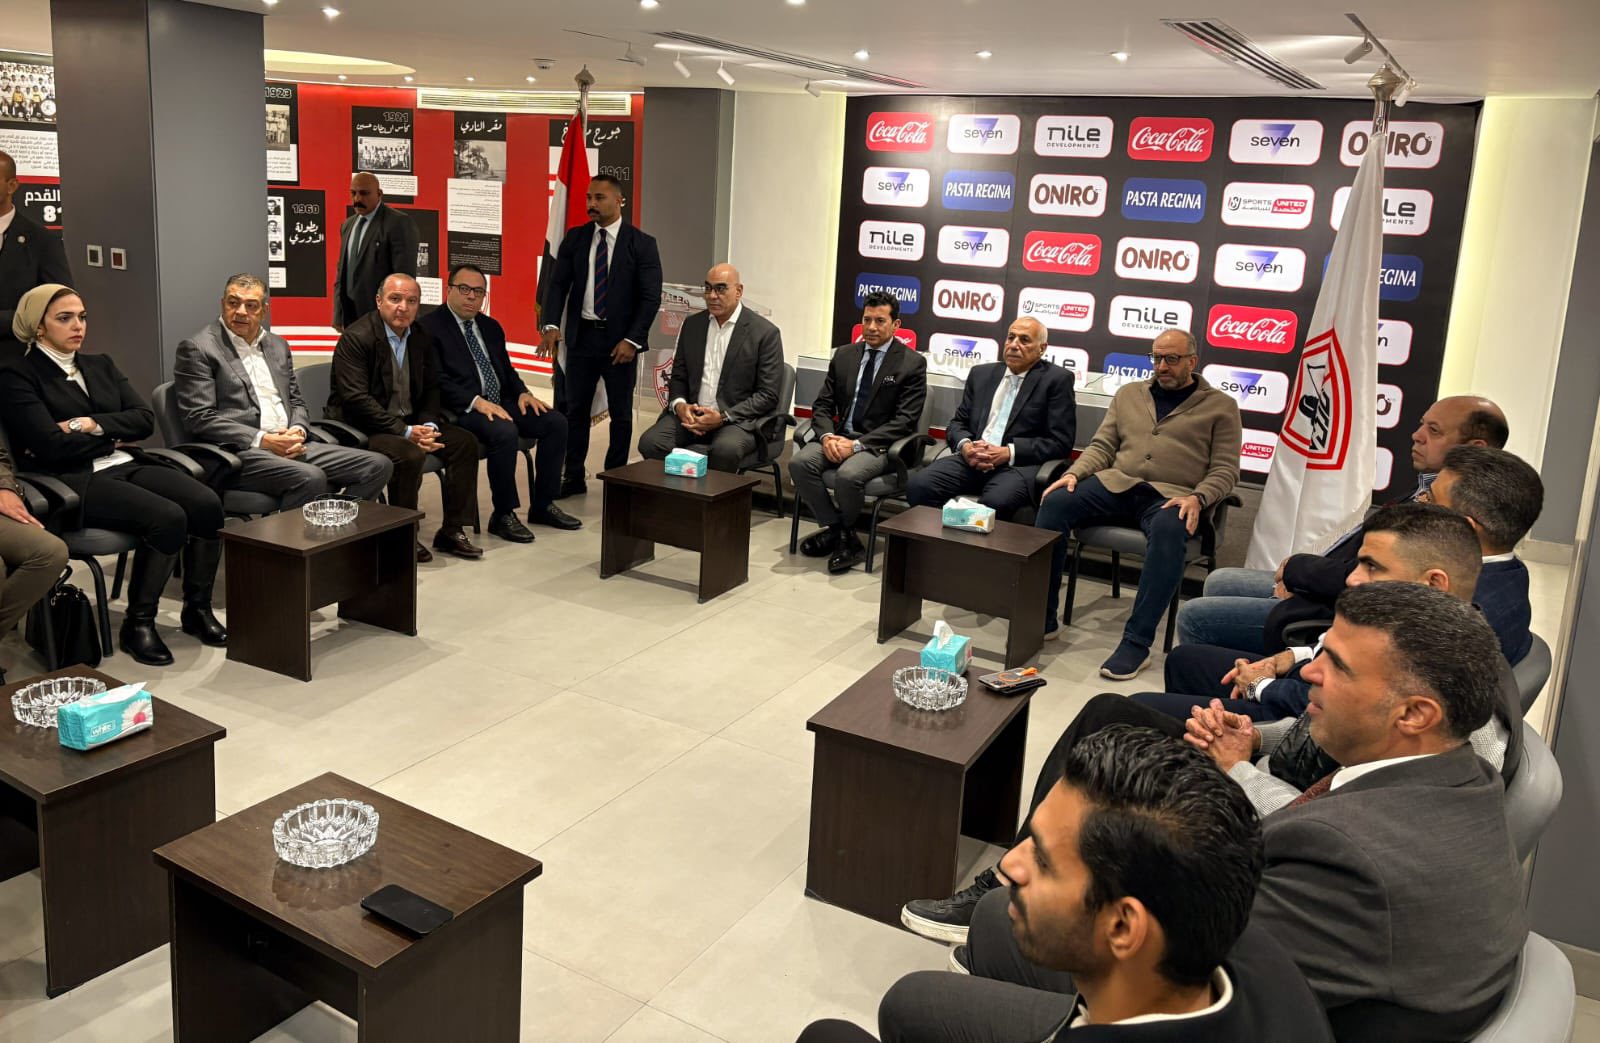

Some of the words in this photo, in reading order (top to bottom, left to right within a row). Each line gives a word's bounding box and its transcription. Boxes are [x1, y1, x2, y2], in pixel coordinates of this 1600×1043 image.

[460, 120, 485, 135] النادي
[869, 120, 930, 144] Coca-Cola
[963, 128, 1003, 139] seven
[1131, 126, 1209, 153] Coca-Cola
[1250, 135, 1300, 148] seven
[1348, 131, 1433, 158] OIRO
[877, 180, 914, 192] seven
[945, 182, 974, 198] PASTA
[975, 183, 1011, 200] REGINA
[1034, 183, 1099, 207] ONIRO
[24, 188, 61, 207] القدم
[1125, 190, 1158, 207] PASTA
[1159, 191, 1202, 210] REGINA
[1276, 199, 1305, 207] UNITED
[292, 204, 320, 214] 1960
[953, 240, 993, 252] seven
[1026, 239, 1097, 267] Coca-Cola
[1121, 247, 1191, 272] ONIRO
[1235, 259, 1284, 274] seven
[1379, 268, 1417, 287] EGINA
[938, 288, 996, 312] ONIRO
[1211, 314, 1292, 345] Coca-Cola
[944, 348, 982, 360] seven
[1220, 381, 1267, 396] seven
[1245, 444, 1273, 453] UNITED
